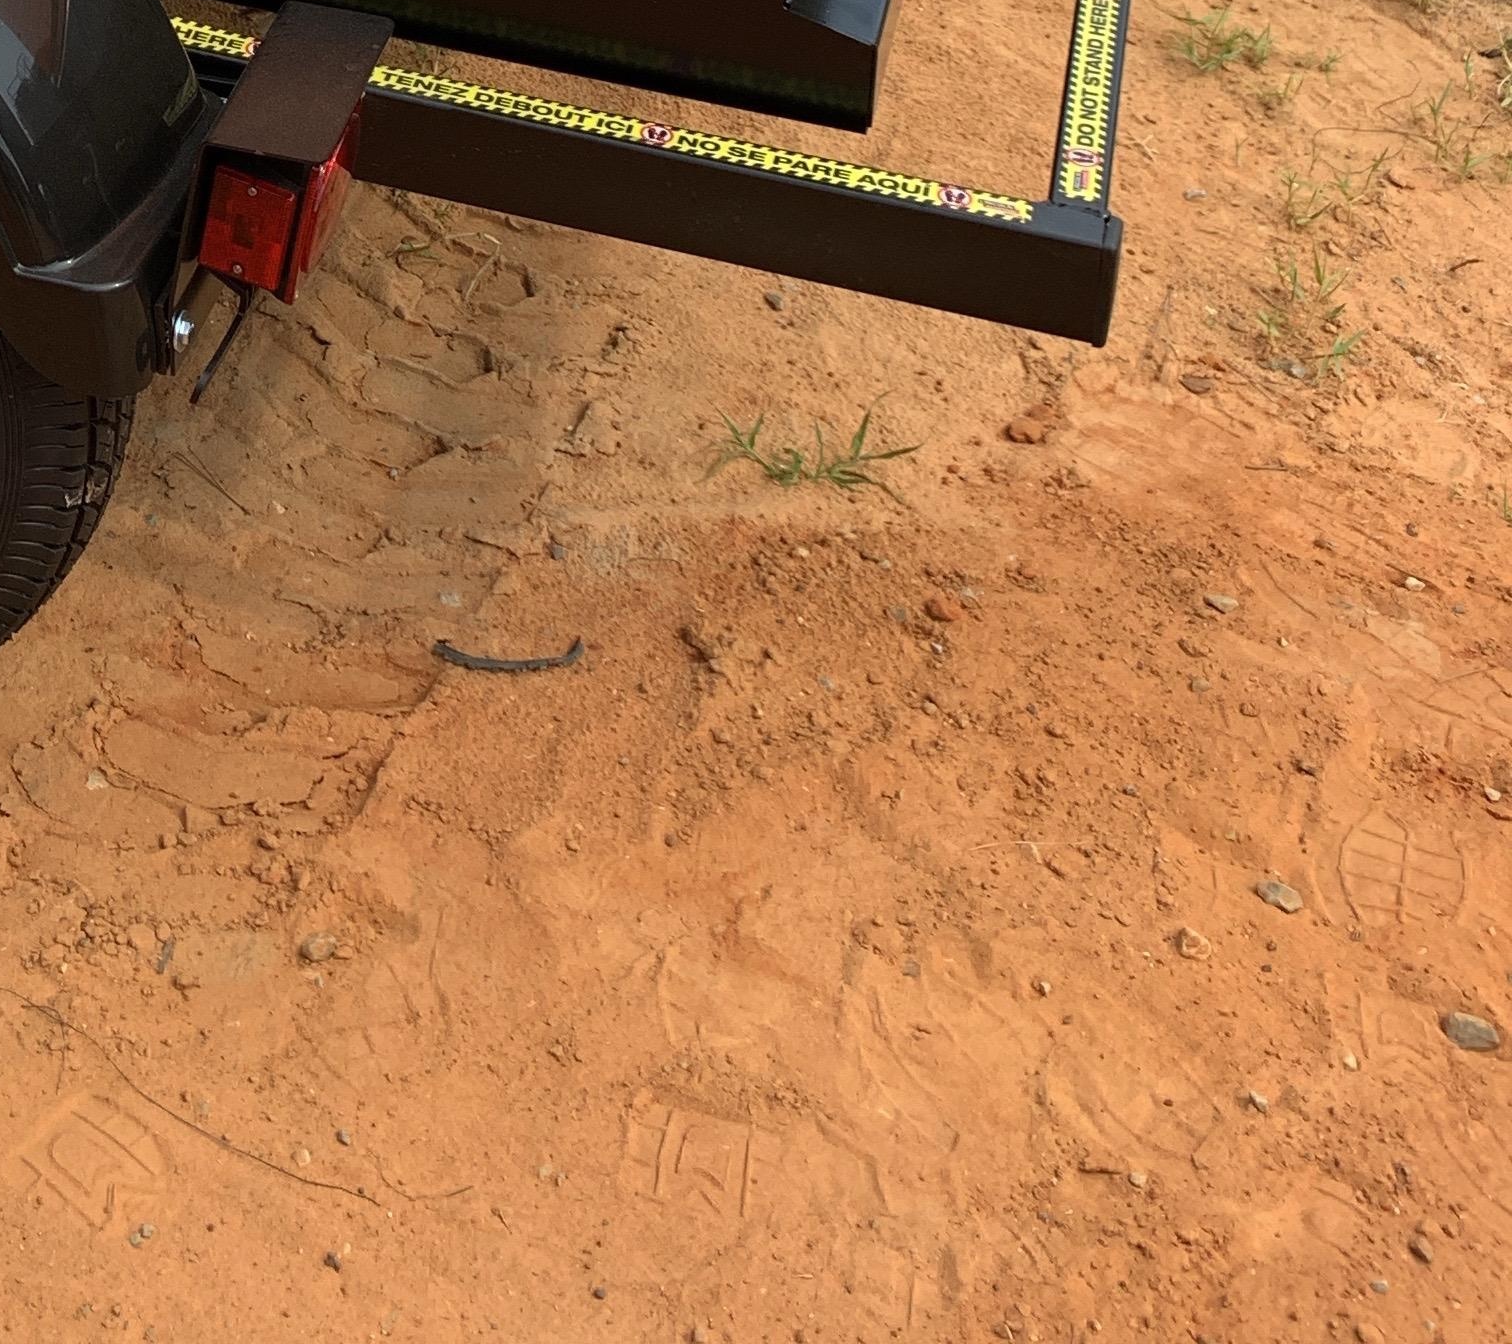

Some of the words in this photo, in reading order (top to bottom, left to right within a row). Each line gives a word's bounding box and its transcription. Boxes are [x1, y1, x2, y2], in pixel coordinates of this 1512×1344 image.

[1082, 37, 1104, 87] STAND
[381, 71, 469, 99] TENEZ
[473, 91, 591, 125] DEBOUT
[597, 118, 634, 135] ICI
[1079, 89, 1100, 117] NOT
[677, 135, 721, 154] NO
[727, 146, 765, 163] SE
[772, 155, 851, 181] PARE
[1076, 123, 1095, 147] DO
